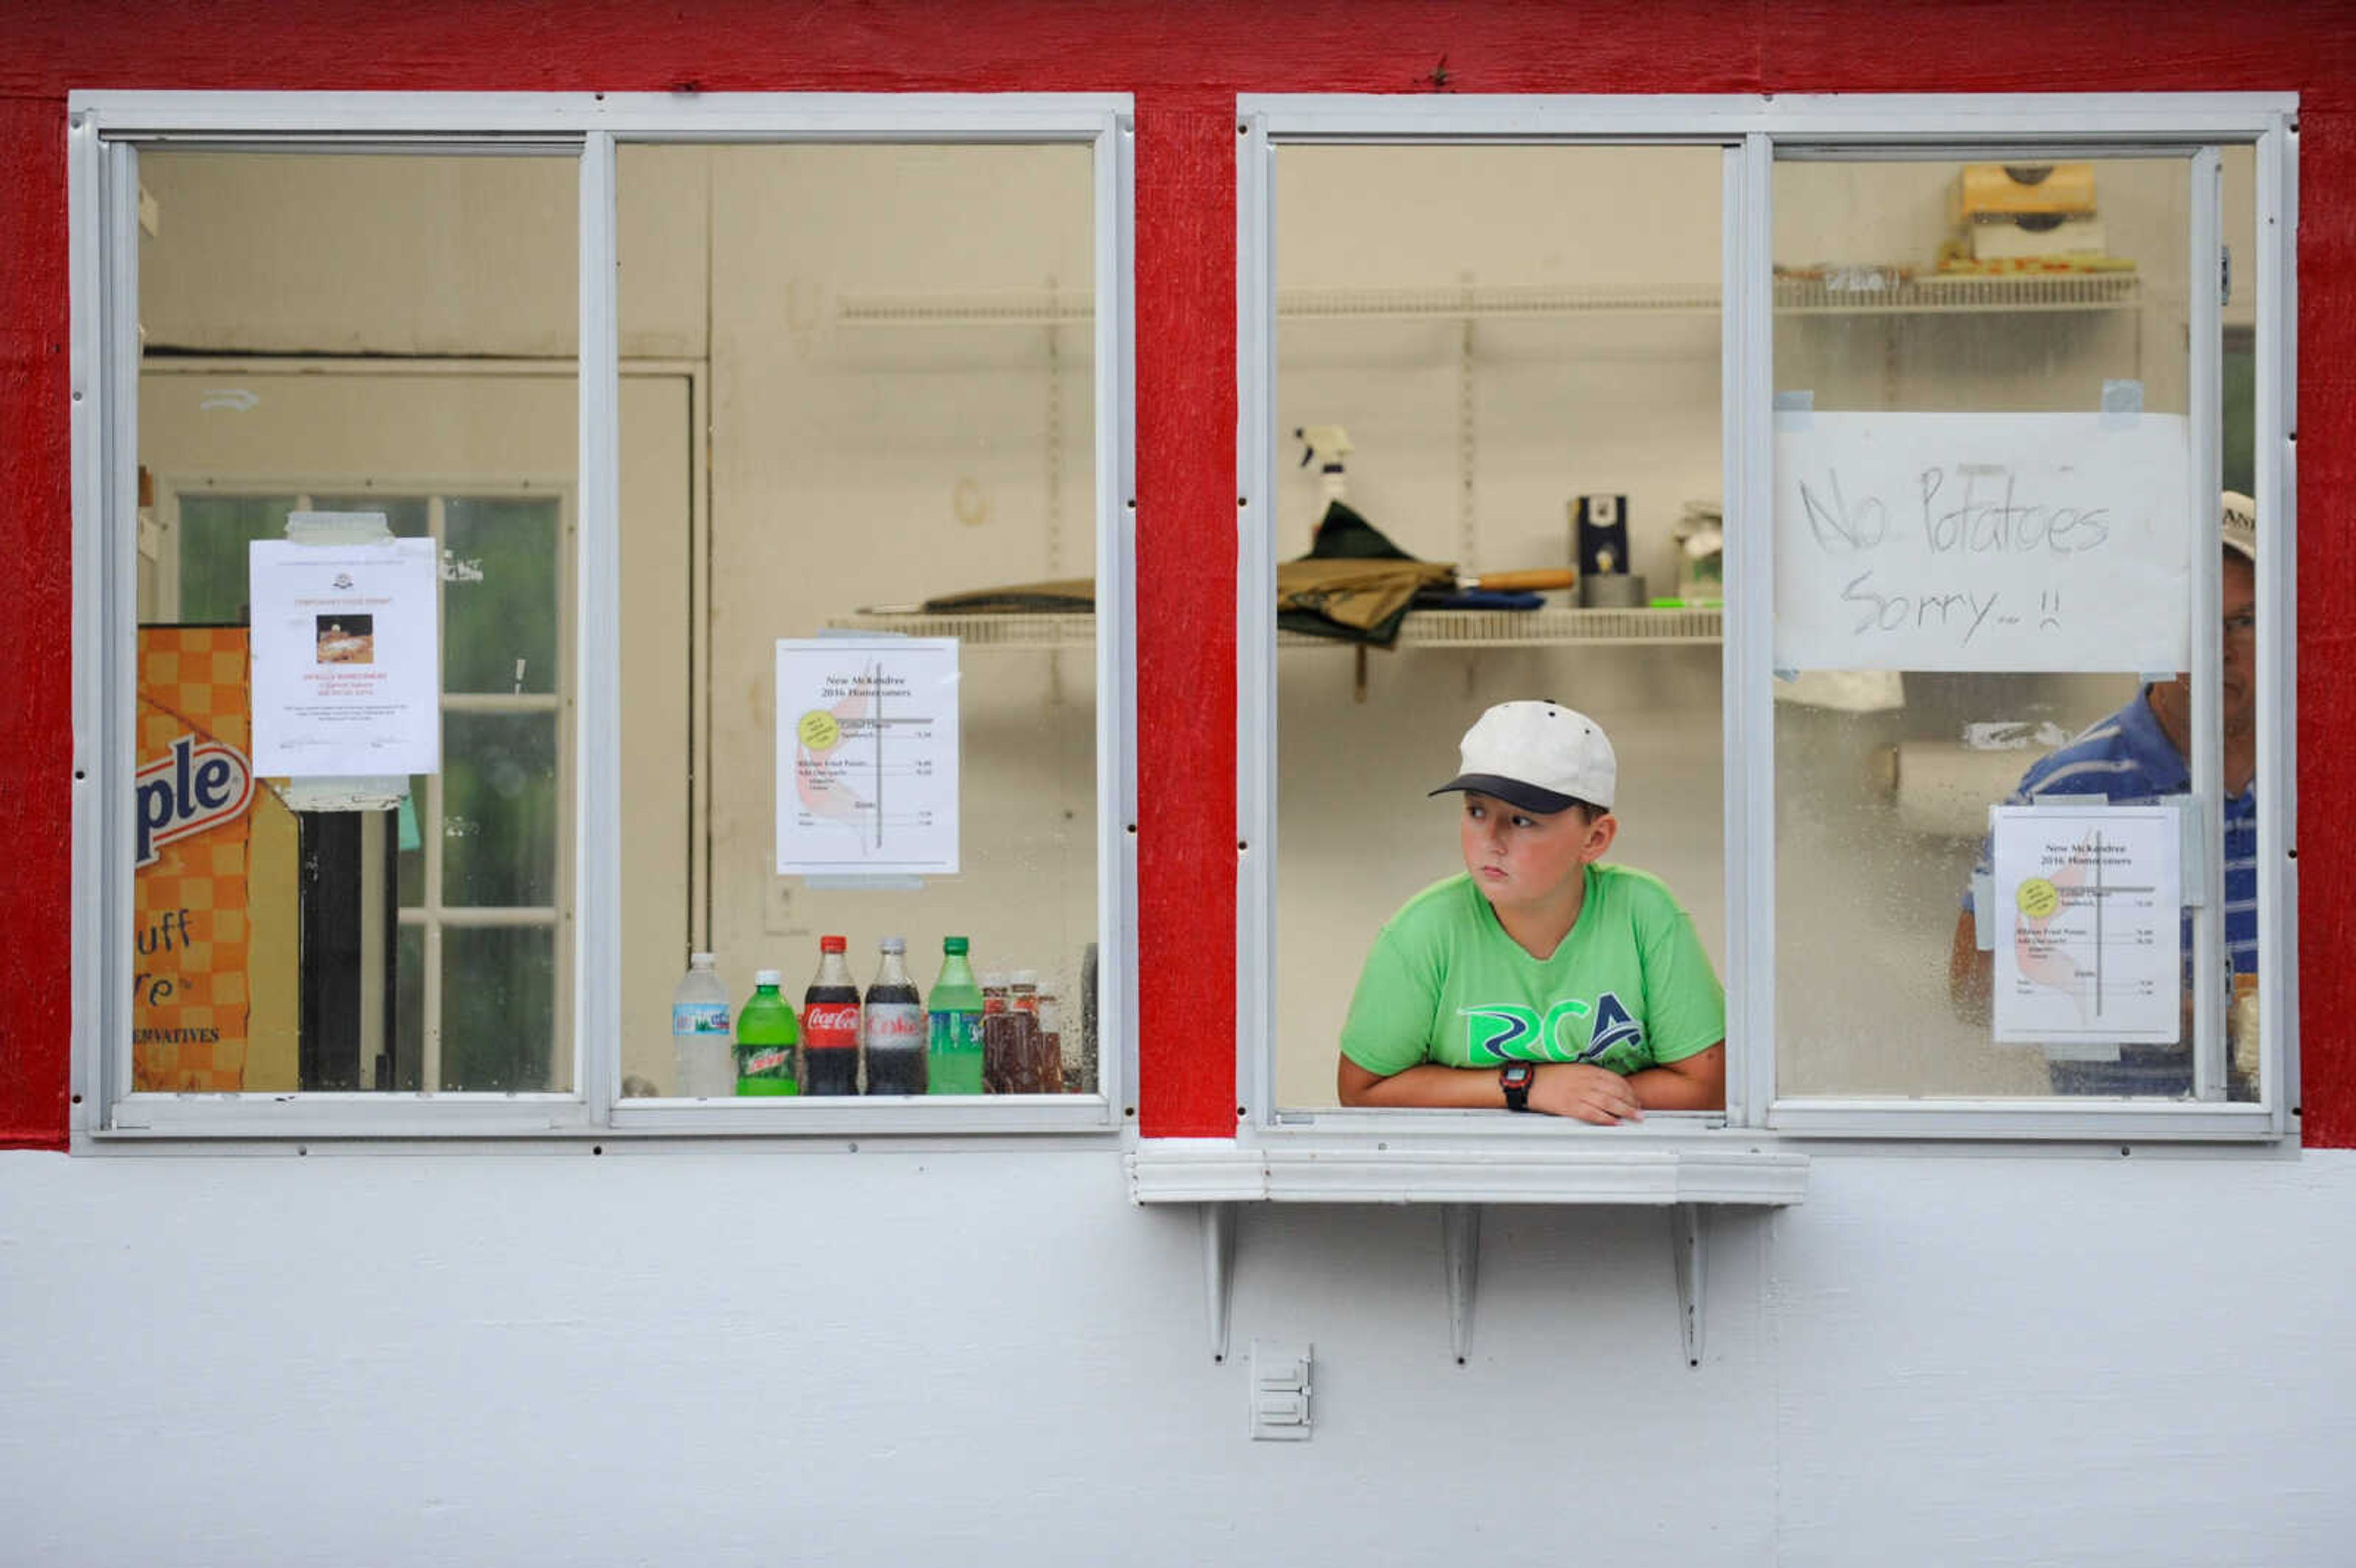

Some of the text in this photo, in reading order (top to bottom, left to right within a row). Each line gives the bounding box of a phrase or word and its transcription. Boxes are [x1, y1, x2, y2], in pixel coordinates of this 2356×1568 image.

[1799, 466, 2109, 554] No Potatoes
[821, 688, 845, 697] 2016
[826, 676, 848, 685] New
[136, 740, 231, 862] ple
[138, 909, 194, 955] uff
[1458, 991, 1642, 1065] RCA
